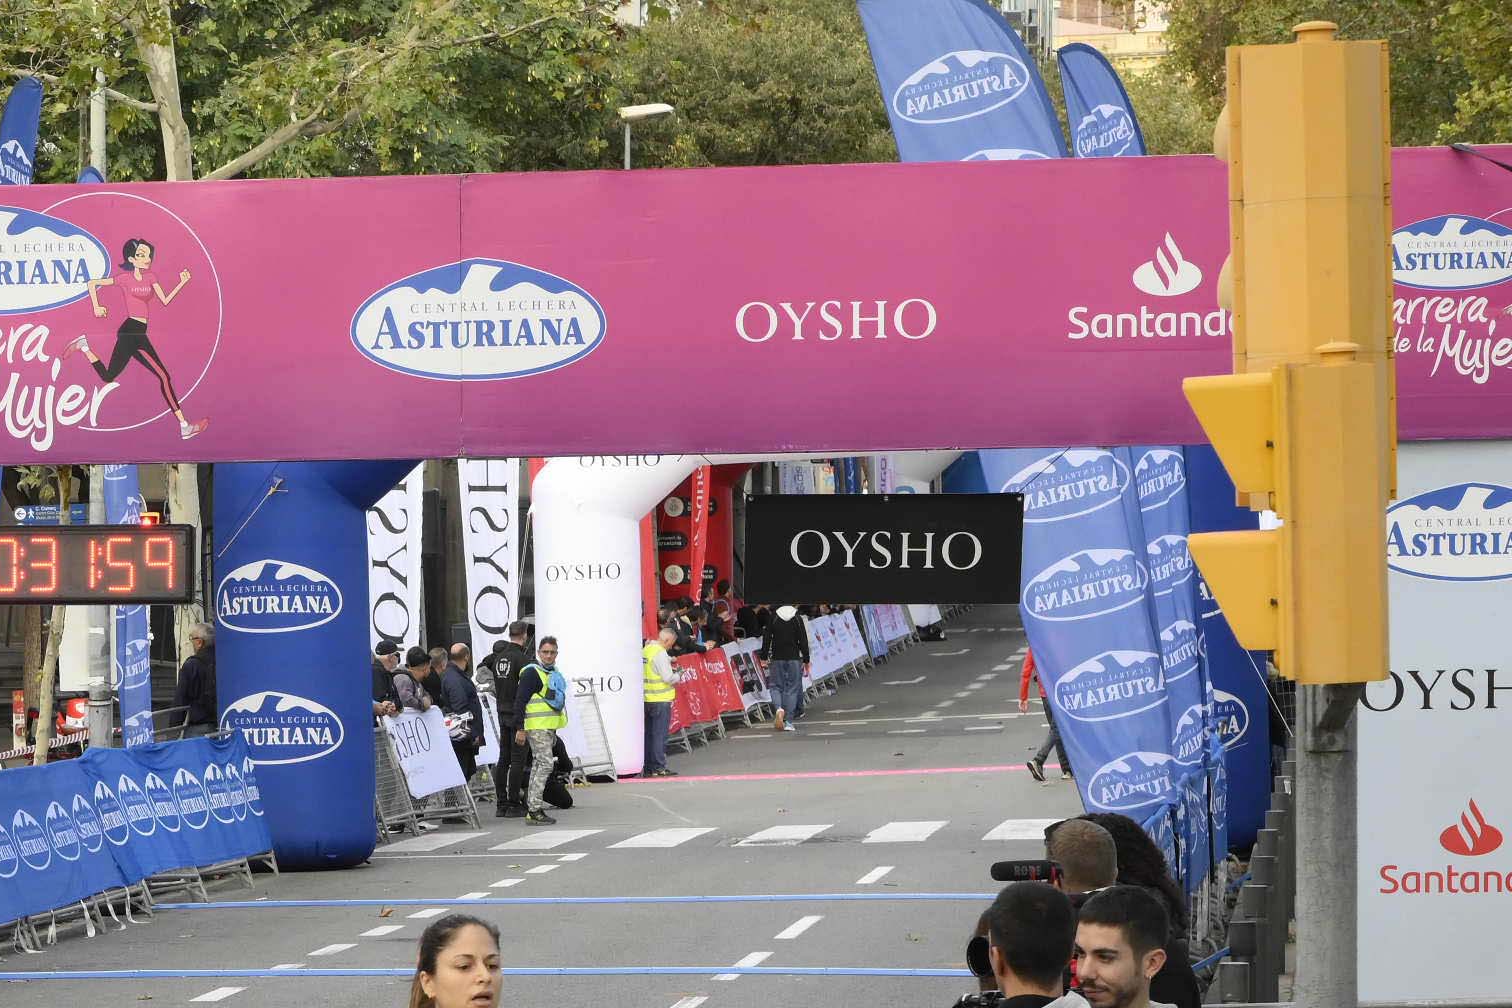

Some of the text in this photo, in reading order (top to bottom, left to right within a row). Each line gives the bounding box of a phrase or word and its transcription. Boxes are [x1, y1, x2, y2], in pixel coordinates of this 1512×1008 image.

[13, 241, 87, 253] LECHERA
[410, 299, 577, 315] CENTRAL LECHERA
[735, 298, 937, 343] OYSHO
[1393, 295, 1489, 325] arrera
[371, 305, 586, 350] ASTURIANA
[1068, 305, 1233, 339] Santand
[1417, 325, 1435, 353] la
[1414, 517, 1481, 528] CENTRAL
[790, 529, 983, 570] OYSHO
[546, 562, 621, 582] OYSHO
[233, 584, 328, 593] CENTRAL LECHERA
[221, 591, 333, 617] ASTURIANA
